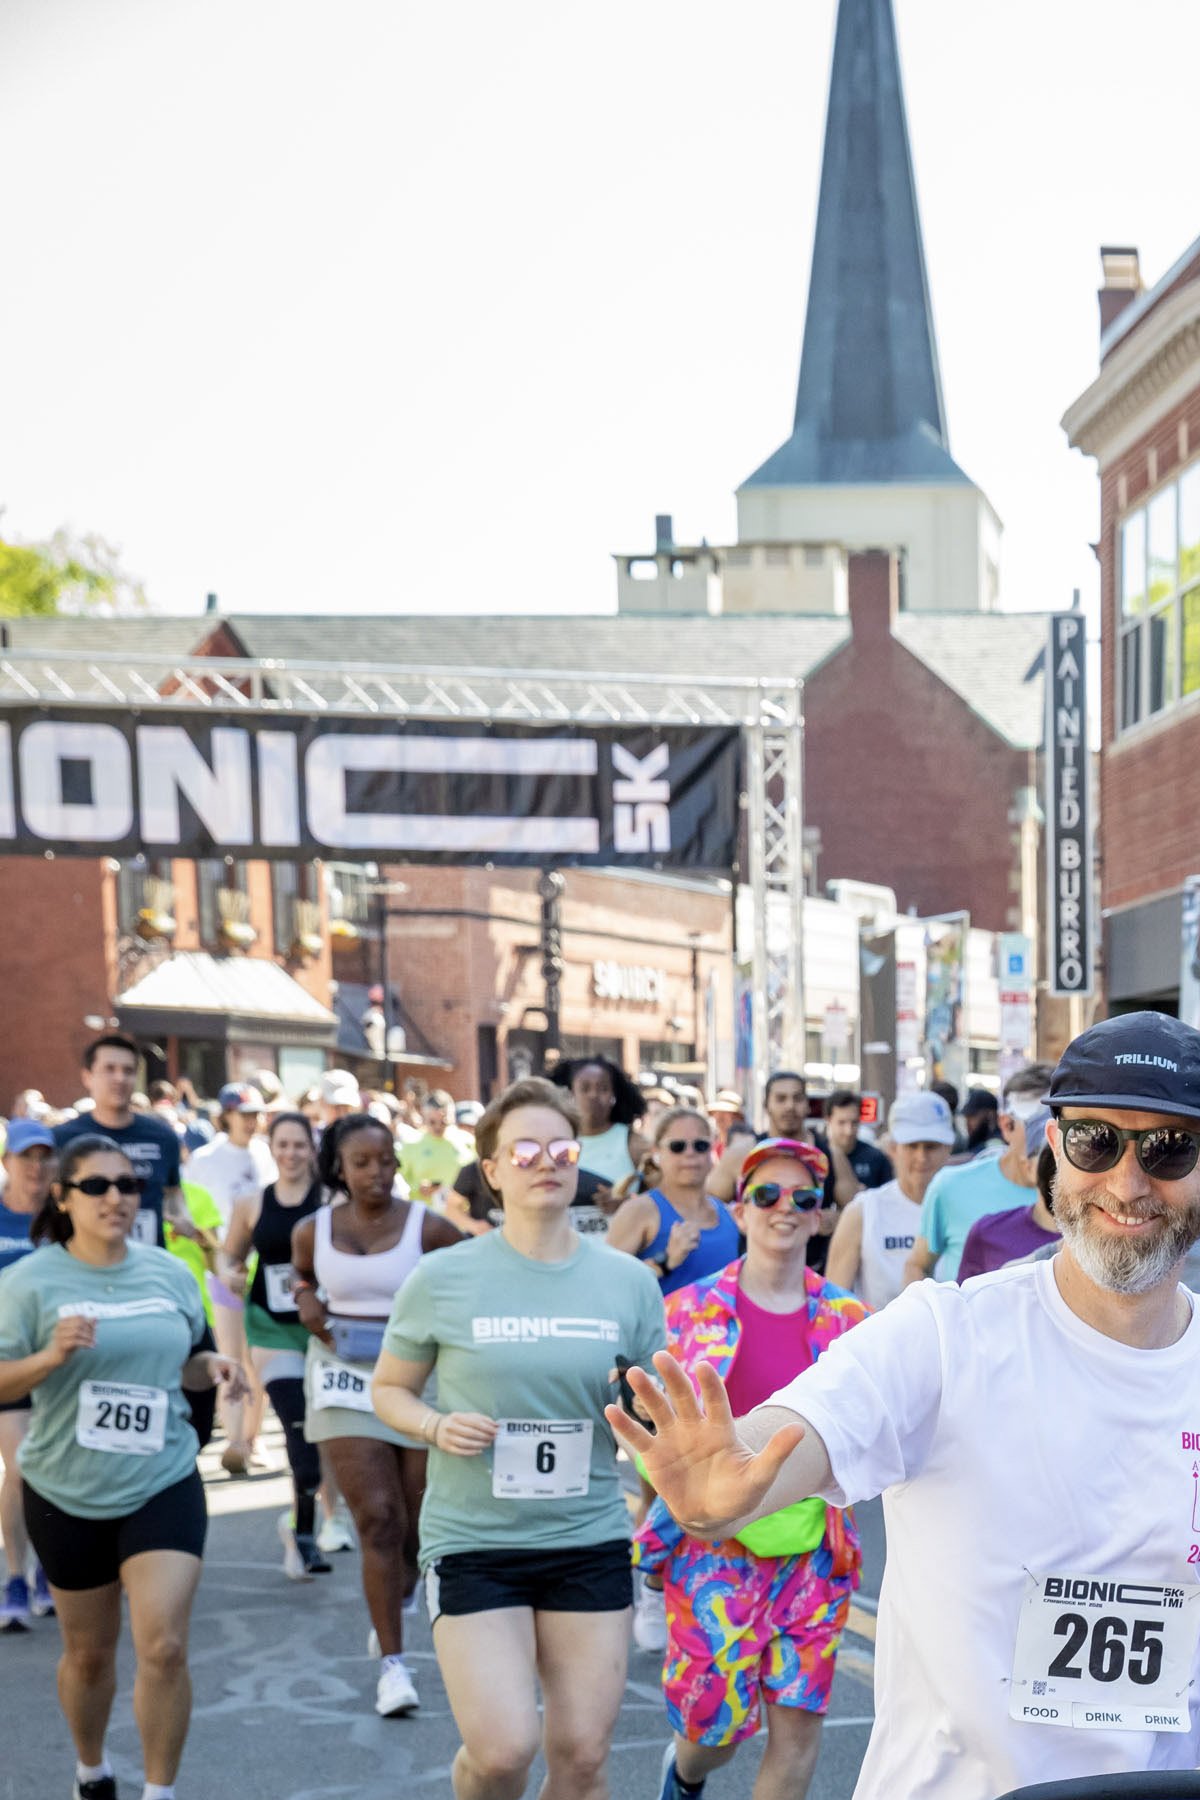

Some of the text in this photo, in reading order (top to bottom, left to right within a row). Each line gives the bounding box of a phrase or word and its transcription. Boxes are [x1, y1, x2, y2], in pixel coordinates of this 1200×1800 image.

[611, 742, 671, 852] 5K
[1056, 617, 1083, 989] PAINTED BURRO
[1114, 1053, 1178, 1072] TRILLIUM
[472, 1317, 600, 1339] BIONIC
[95, 1401, 151, 1433] 269
[507, 1422, 576, 1435] BIONIC
[536, 1441, 556, 1474] 6
[1044, 1577, 1164, 1606] BIONIC
[1048, 1613, 1165, 1685] 265
[1023, 1706, 1059, 1719] FOOD
[1085, 1712, 1123, 1723] DRINK
[1144, 1715, 1181, 1726] DRINK
